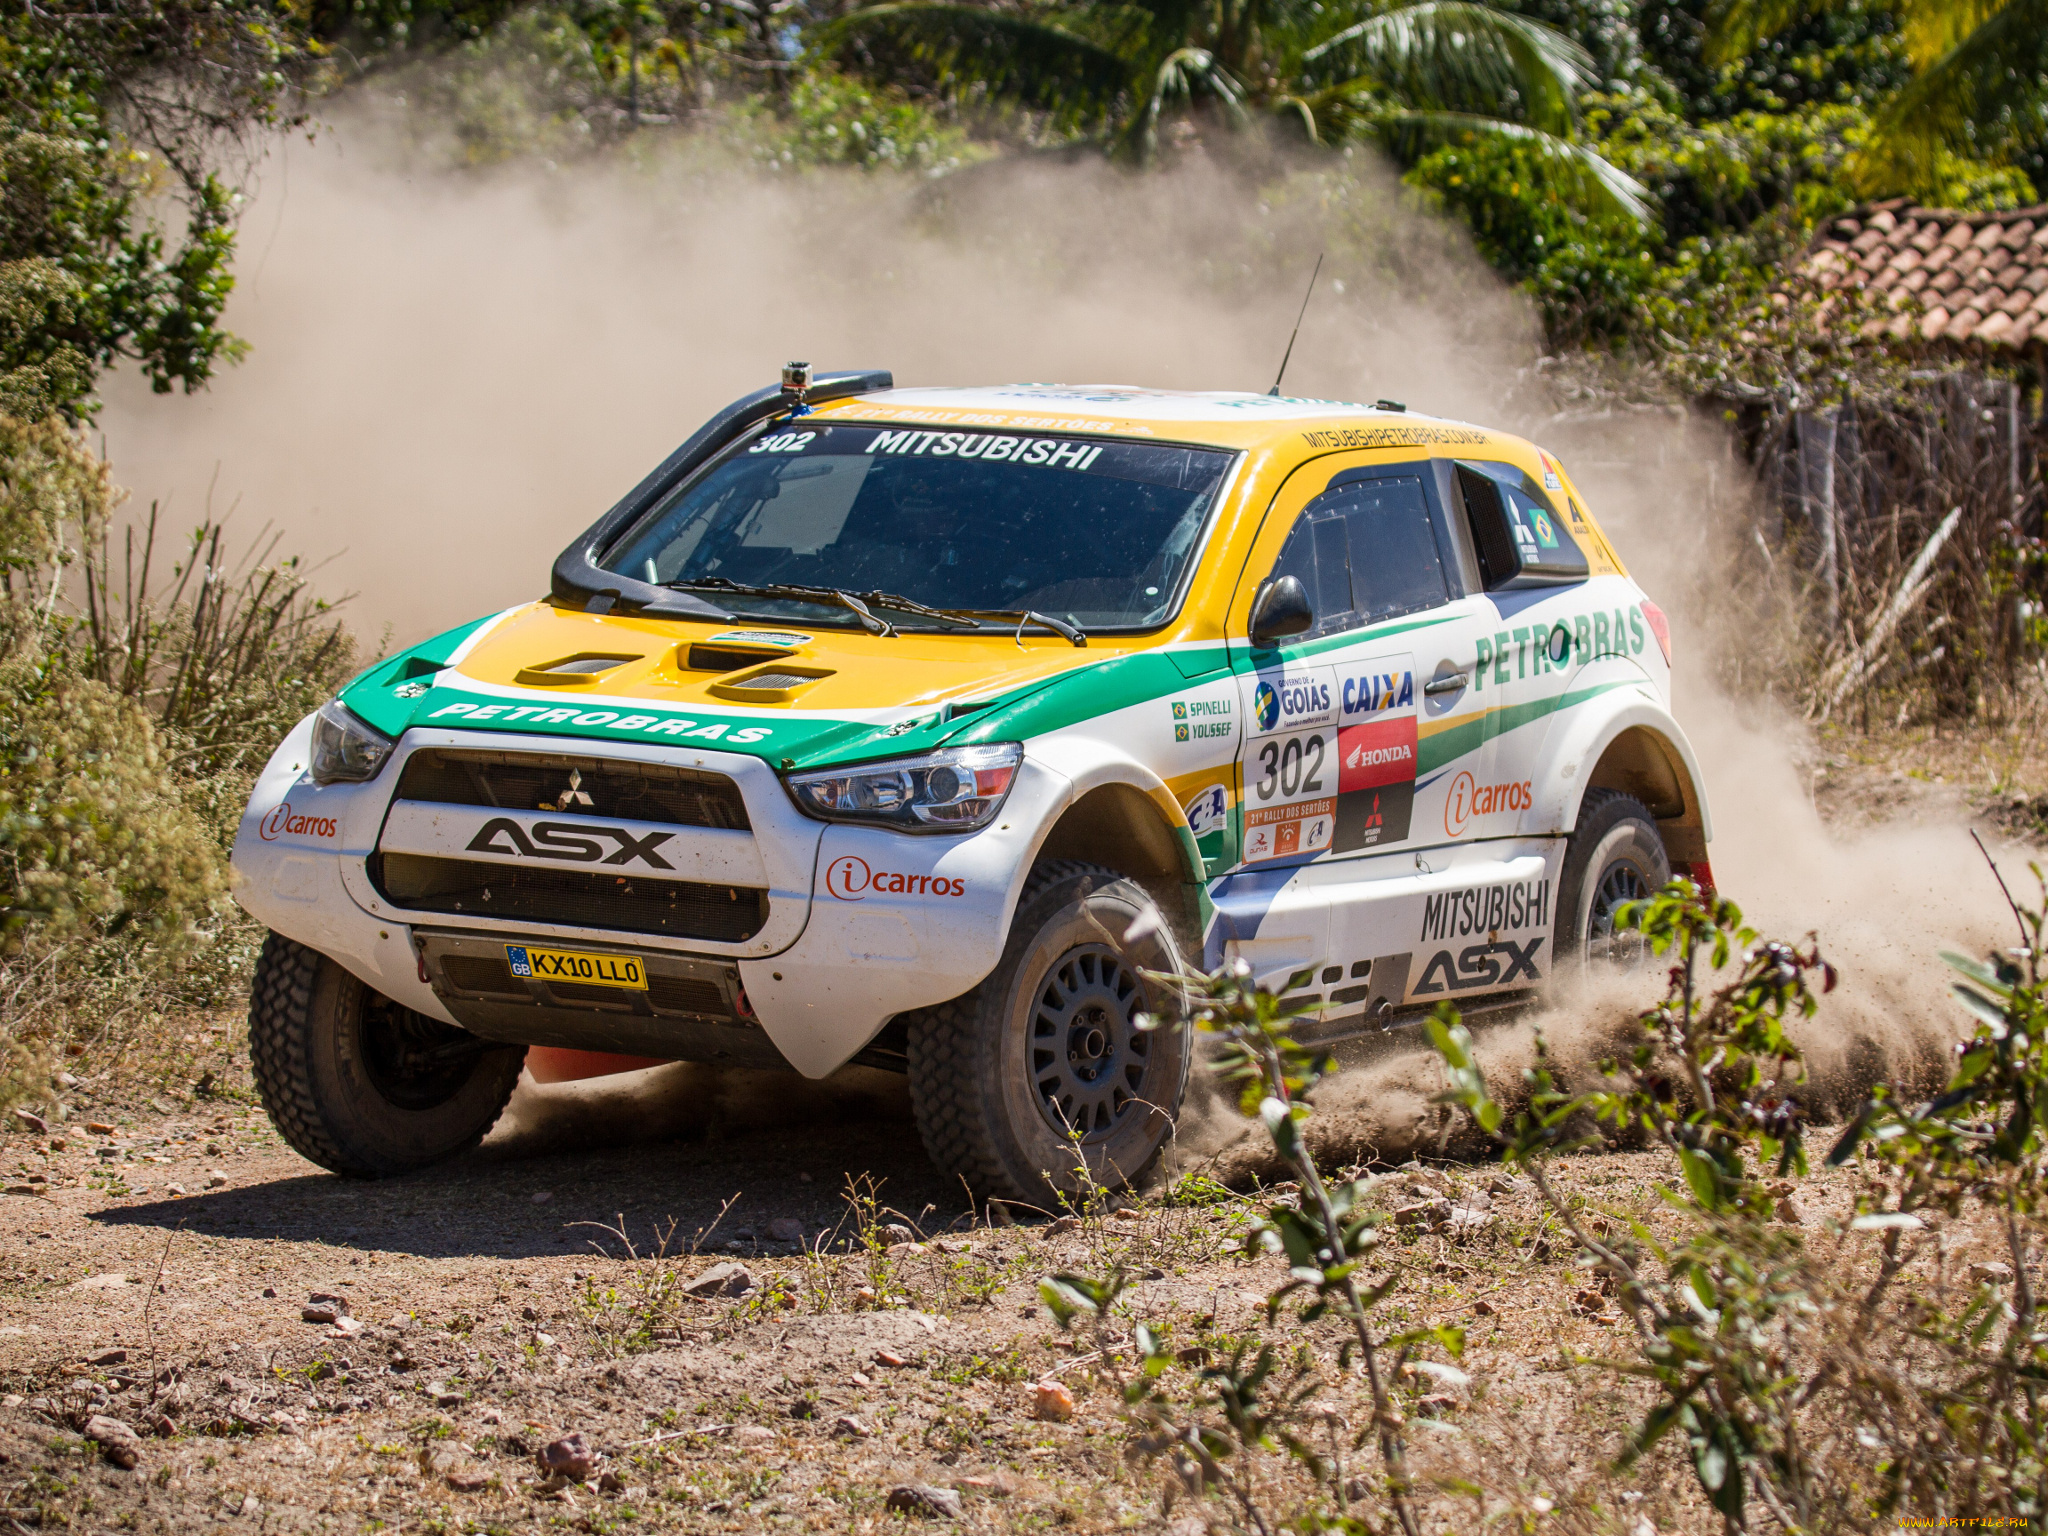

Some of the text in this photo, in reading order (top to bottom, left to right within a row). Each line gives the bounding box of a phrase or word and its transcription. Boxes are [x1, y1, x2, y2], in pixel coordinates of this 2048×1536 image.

[894, 410, 960, 422] RALLY
[963, 413, 1008, 424] DOS
[1009, 415, 1114, 432] SERTÕES
[749, 431, 817, 454] 302
[865, 431, 1103, 470] MITSUBISHI
[1301, 428, 1491, 448] MITSUBISHIPETROBRAS.COM.BR
[1475, 605, 1645, 692] PETROBRAS
[1190, 700, 1231, 716] SPINELLI
[1282, 678, 1331, 715] GOIÁS
[1343, 671, 1414, 714] CAIXA
[428, 703, 773, 744] PETROBRAS
[1193, 722, 1232, 739] YOUSSEF
[1257, 734, 1325, 801] 302
[1362, 745, 1412, 767] HONDA
[1264, 809, 1285, 822] RALLY
[1286, 805, 1299, 819] DOS
[1301, 800, 1331, 816] SERTÕES
[465, 818, 676, 870] ASX
[1420, 879, 1550, 942] MITSUBISHI
[512, 963, 531, 975] GB
[531, 953, 593, 978] KX10
[1410, 937, 1546, 996] ASX
